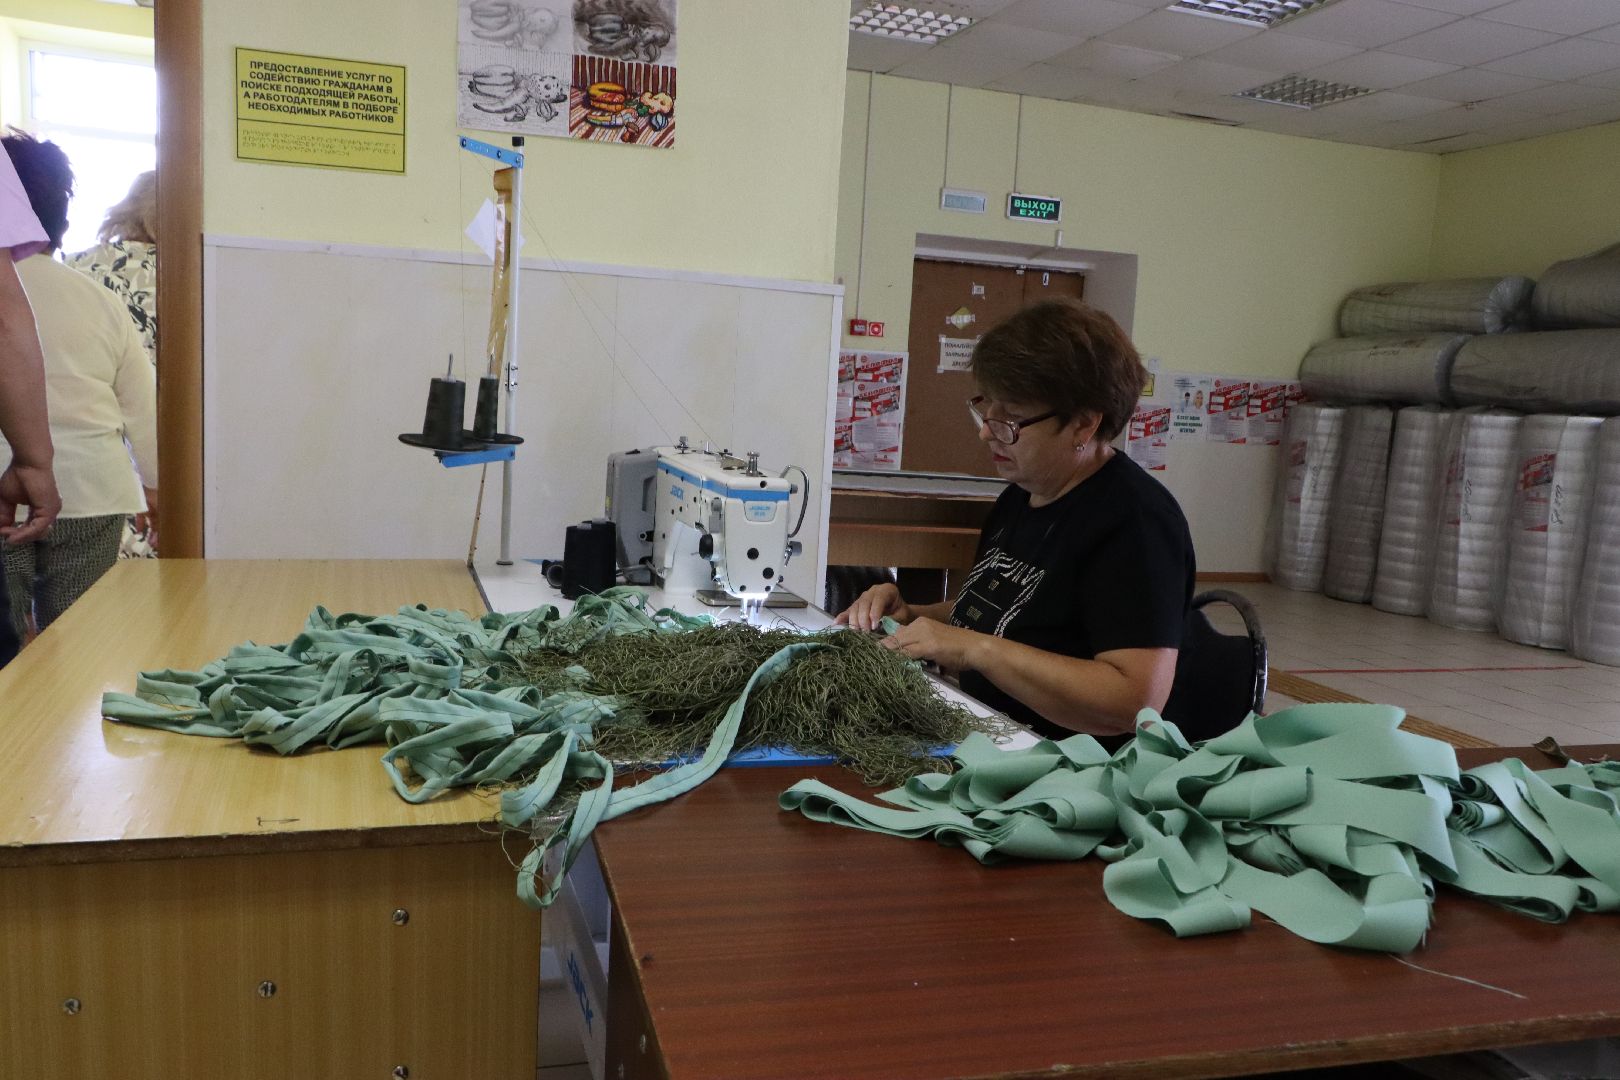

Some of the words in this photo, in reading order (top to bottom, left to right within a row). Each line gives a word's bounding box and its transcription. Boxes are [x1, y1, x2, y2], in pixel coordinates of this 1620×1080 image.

[249, 71, 320, 86] СОДЕЙСТВИЮ
[323, 80, 384, 93] ГРАЖДАНАМ
[386, 86, 393, 94] В
[250, 61, 343, 78] ПРЕДОСТАВЛЕНИЕ
[346, 72, 376, 82] УСЛУГ
[378, 75, 393, 84] ПО
[240, 81, 282, 92] ПОИСКЕ
[284, 84, 355, 100] ПОДХОДЯЩЕЙ
[357, 93, 401, 106] РАБОТЫ,
[243, 91, 251, 99] А
[253, 92, 340, 108] РАБОТОДАТЕЛЯМ
[342, 101, 349, 109] В
[352, 102, 399, 114] ПОДБОРЕ
[248, 102, 327, 117] НЕОБХОДИМЫХ
[329, 109, 394, 123] РАБОТНИКОВ
[1014, 199, 1055, 212] ВЫХОД
[1019, 209, 1049, 217] EXIT
